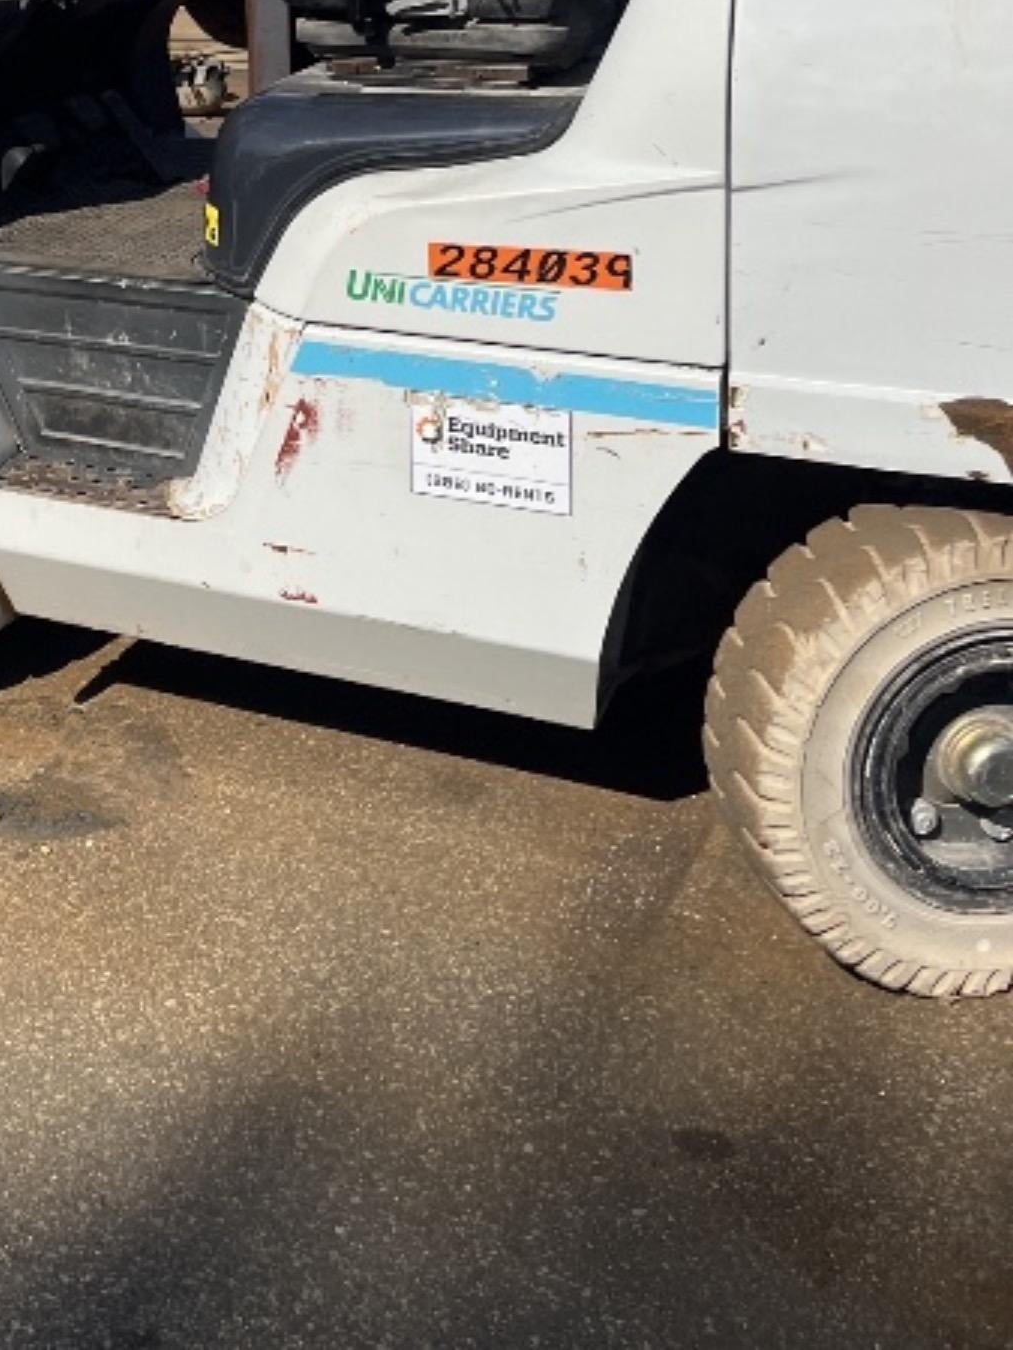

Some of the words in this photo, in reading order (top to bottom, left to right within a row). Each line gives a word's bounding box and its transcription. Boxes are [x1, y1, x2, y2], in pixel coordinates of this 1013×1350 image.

[433, 243, 633, 289] 284039
[448, 416, 565, 448] Equipment
[448, 435, 511, 460] Share
